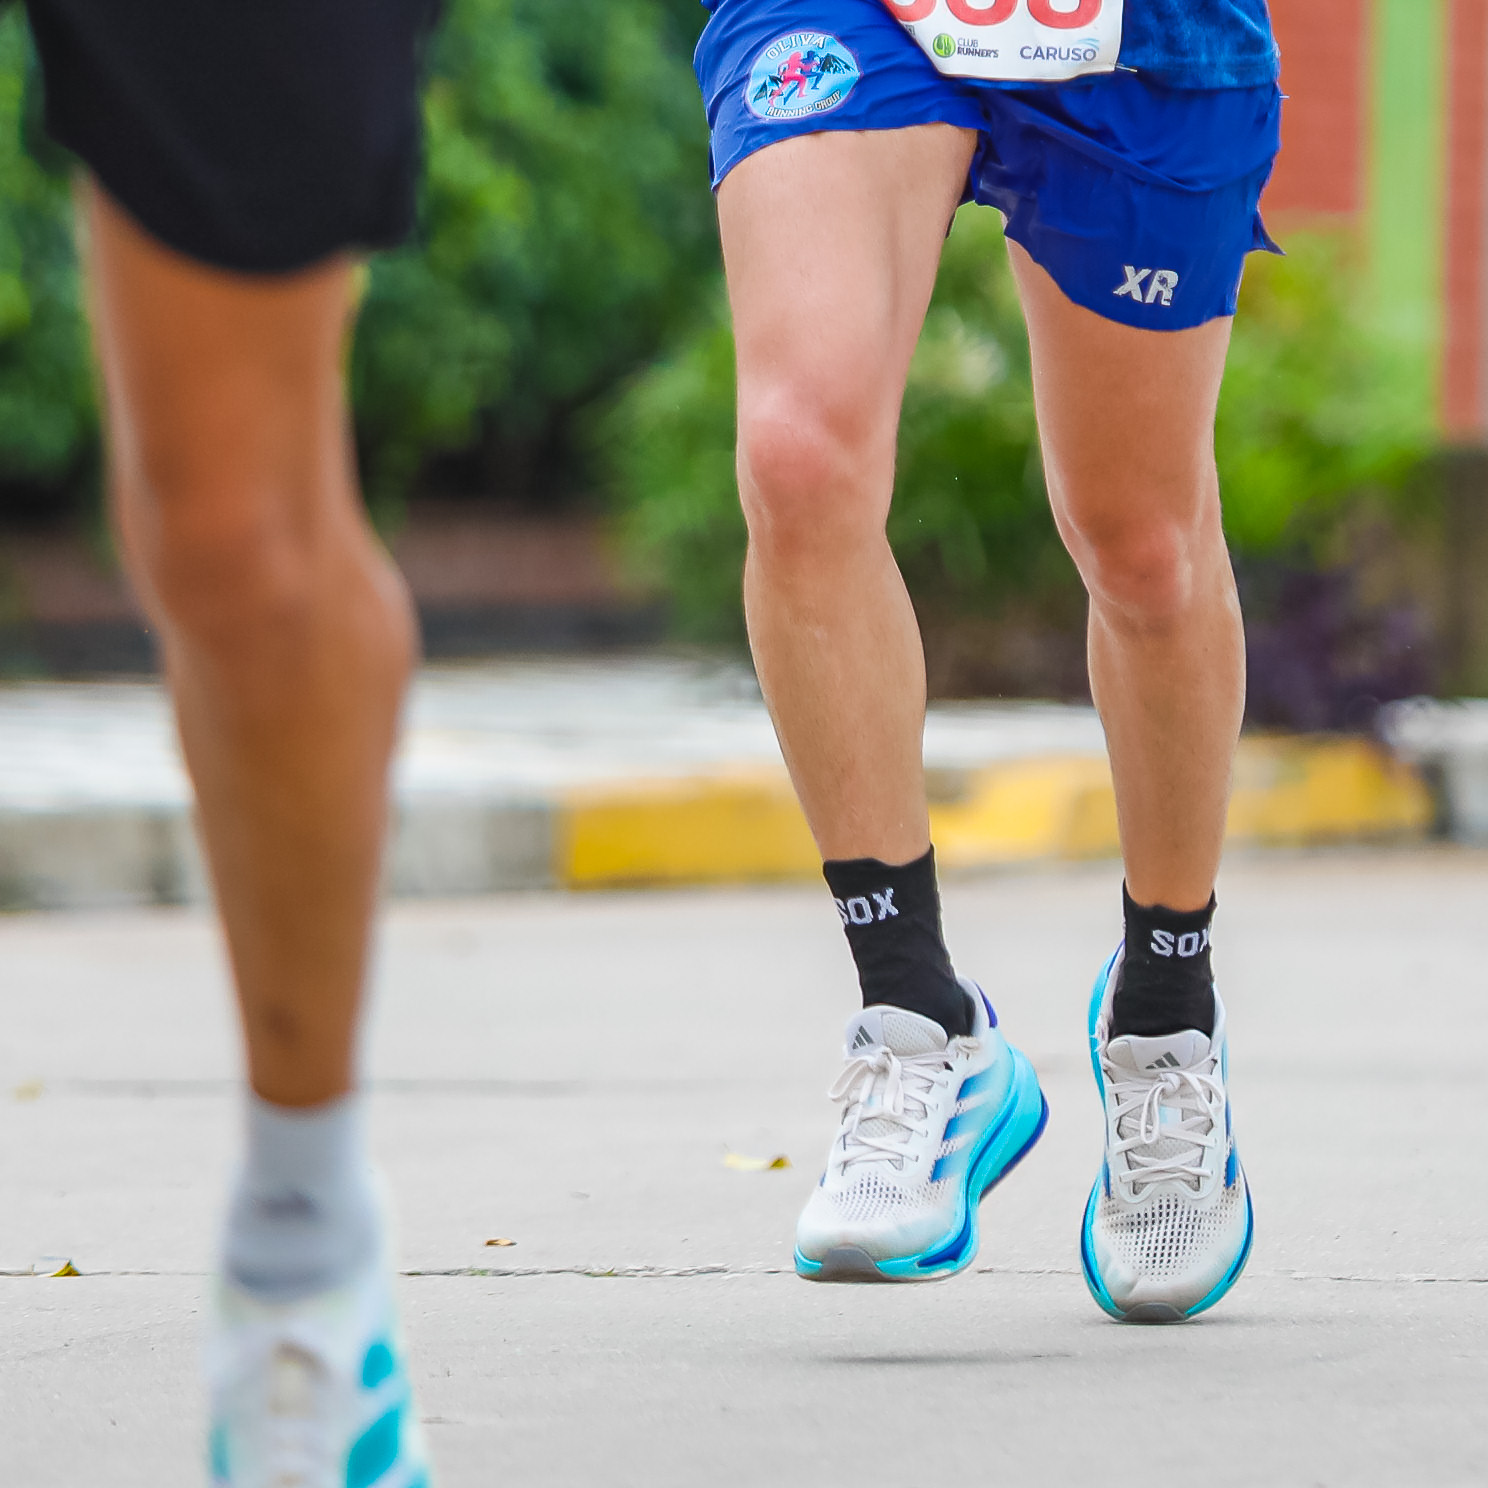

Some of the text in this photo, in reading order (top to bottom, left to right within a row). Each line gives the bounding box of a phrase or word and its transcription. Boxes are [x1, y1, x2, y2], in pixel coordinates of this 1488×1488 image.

[766, 33, 827, 60] OLIVA
[956, 46, 999, 59] RUNNER'S
[957, 36, 979, 49] CLUB
[1019, 45, 1097, 62] CARUSO
[764, 89, 842, 118] RUNNING GROUP
[1112, 265, 1179, 306] XR
